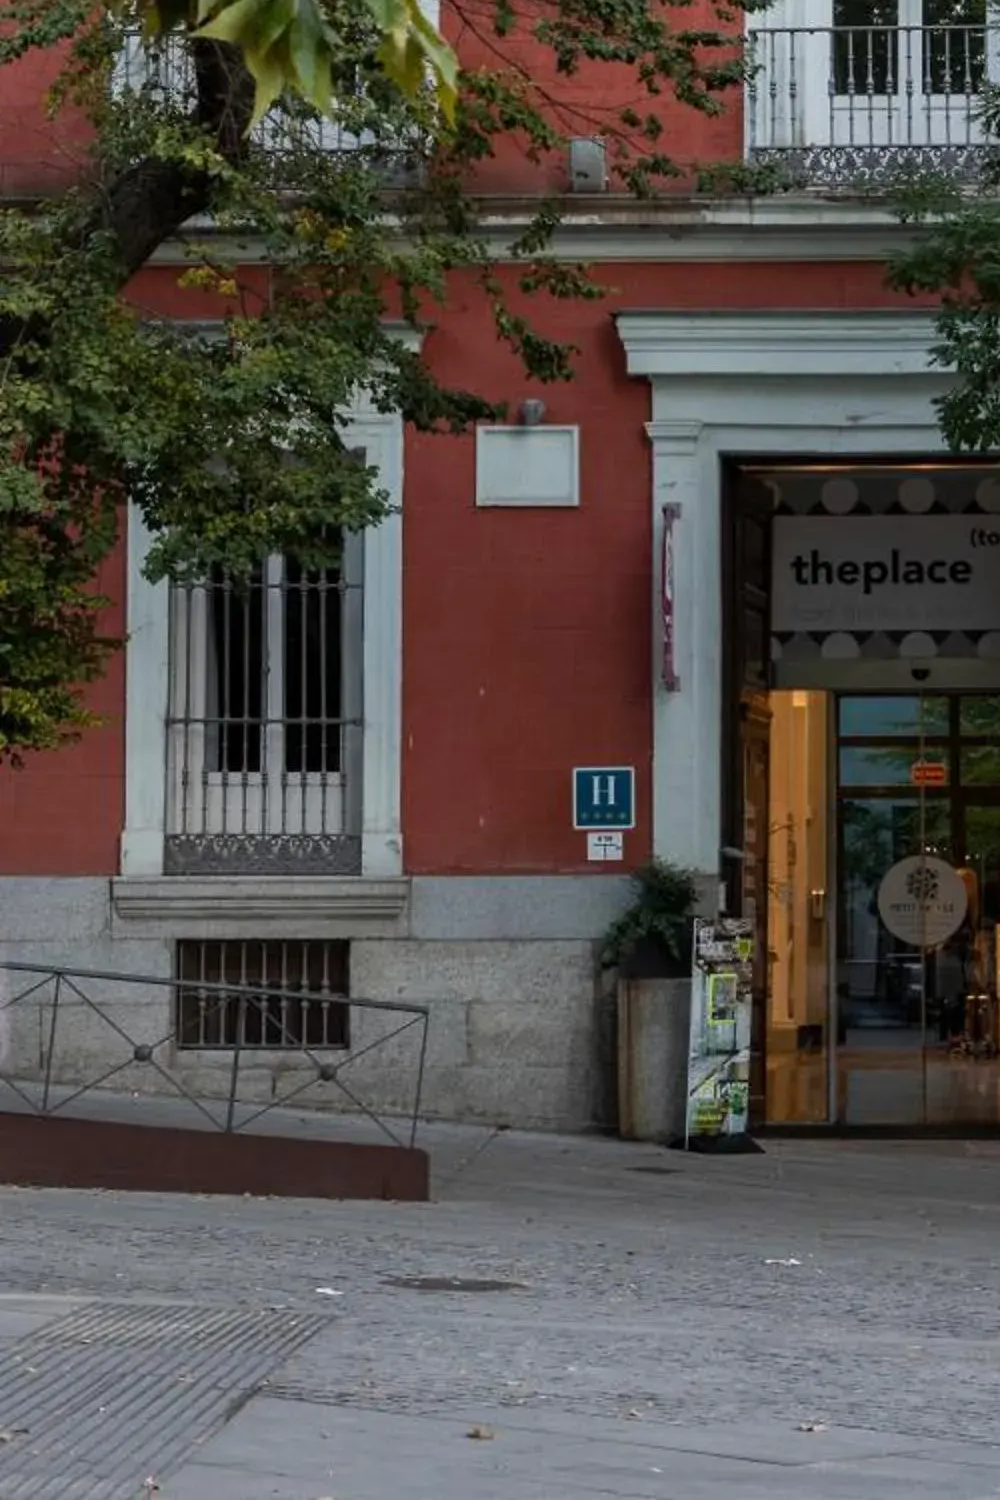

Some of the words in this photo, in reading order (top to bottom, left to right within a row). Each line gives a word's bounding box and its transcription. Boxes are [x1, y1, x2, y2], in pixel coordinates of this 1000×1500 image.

[970, 527, 1000, 548] (to
[790, 549, 973, 595] theplace
[592, 775, 616, 805] H
